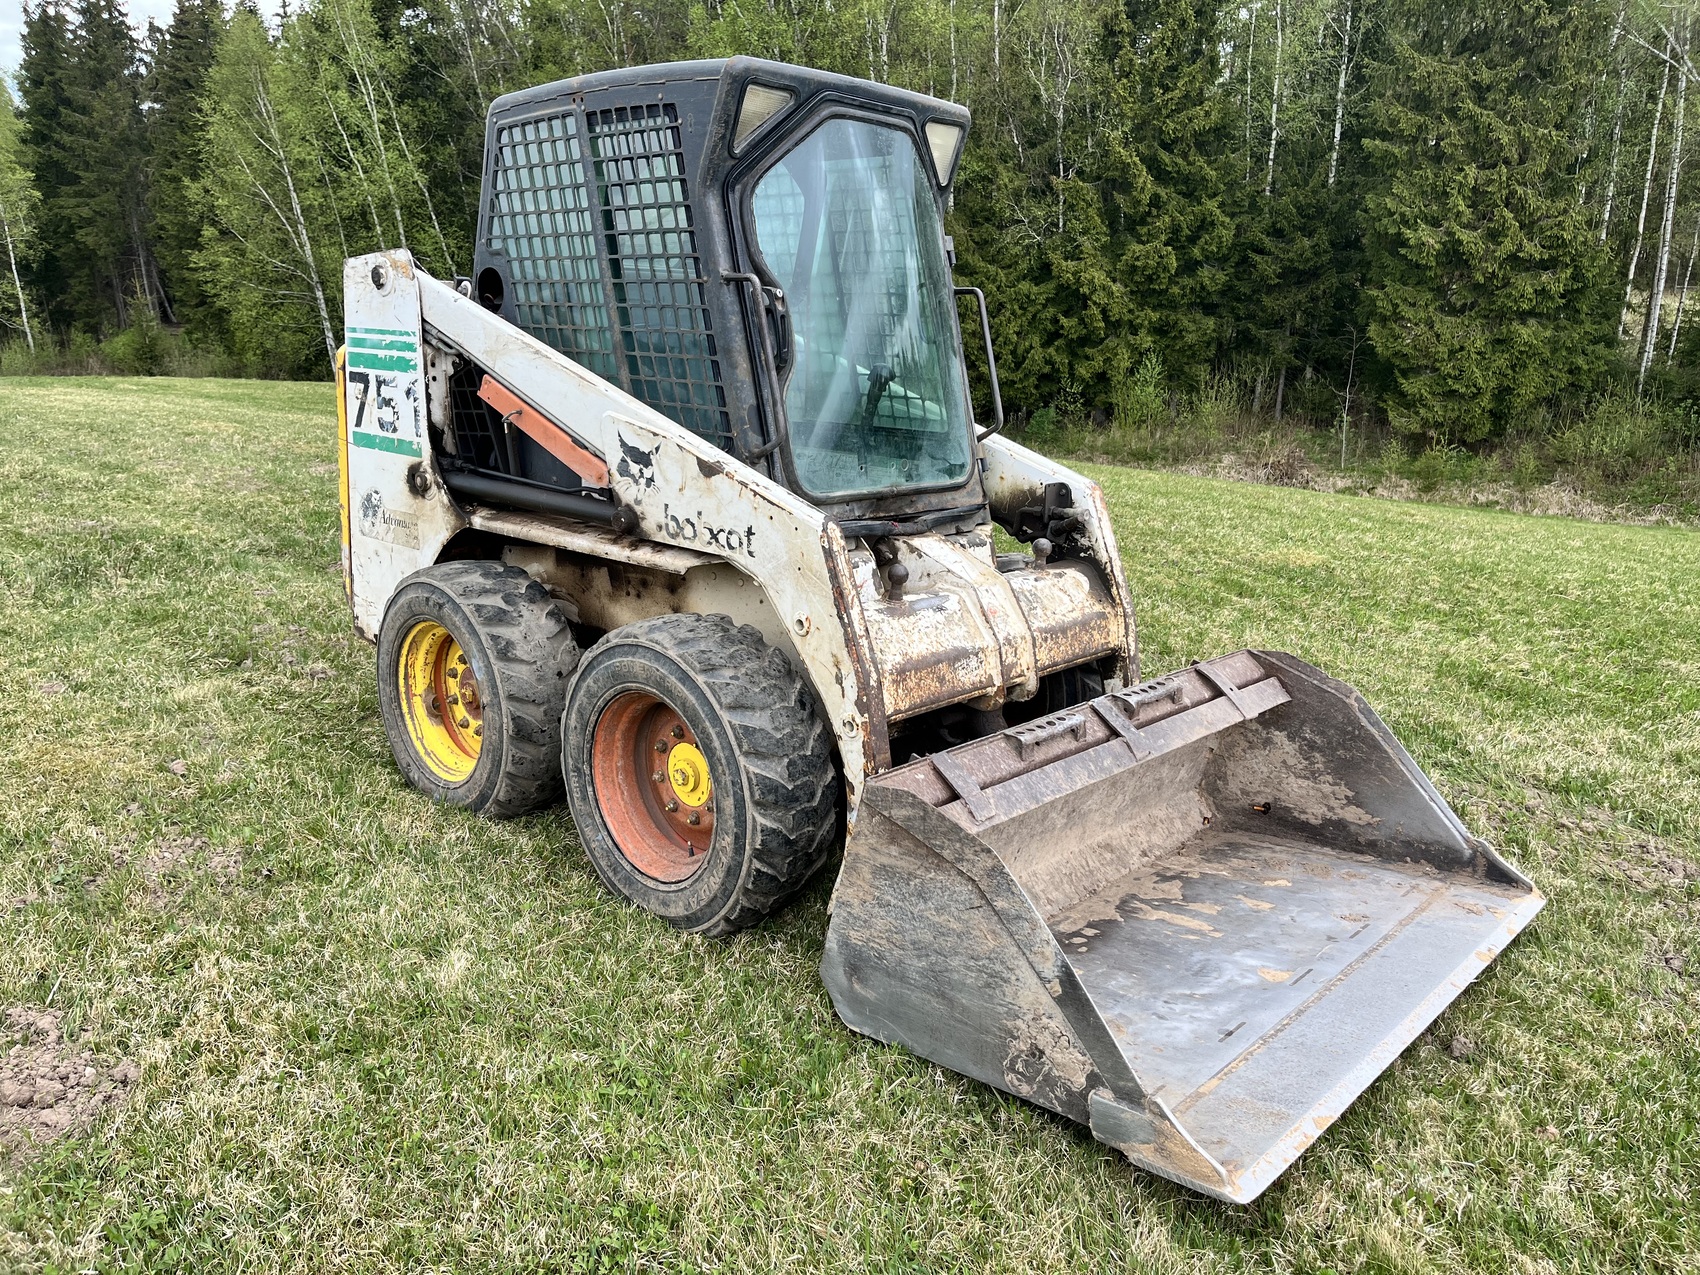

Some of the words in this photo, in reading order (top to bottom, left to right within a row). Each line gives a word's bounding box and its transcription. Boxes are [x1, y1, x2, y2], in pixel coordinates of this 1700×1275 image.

[348, 371, 422, 438] 751
[663, 502, 756, 559] bobcat
[688, 832, 731, 910] KENDA
